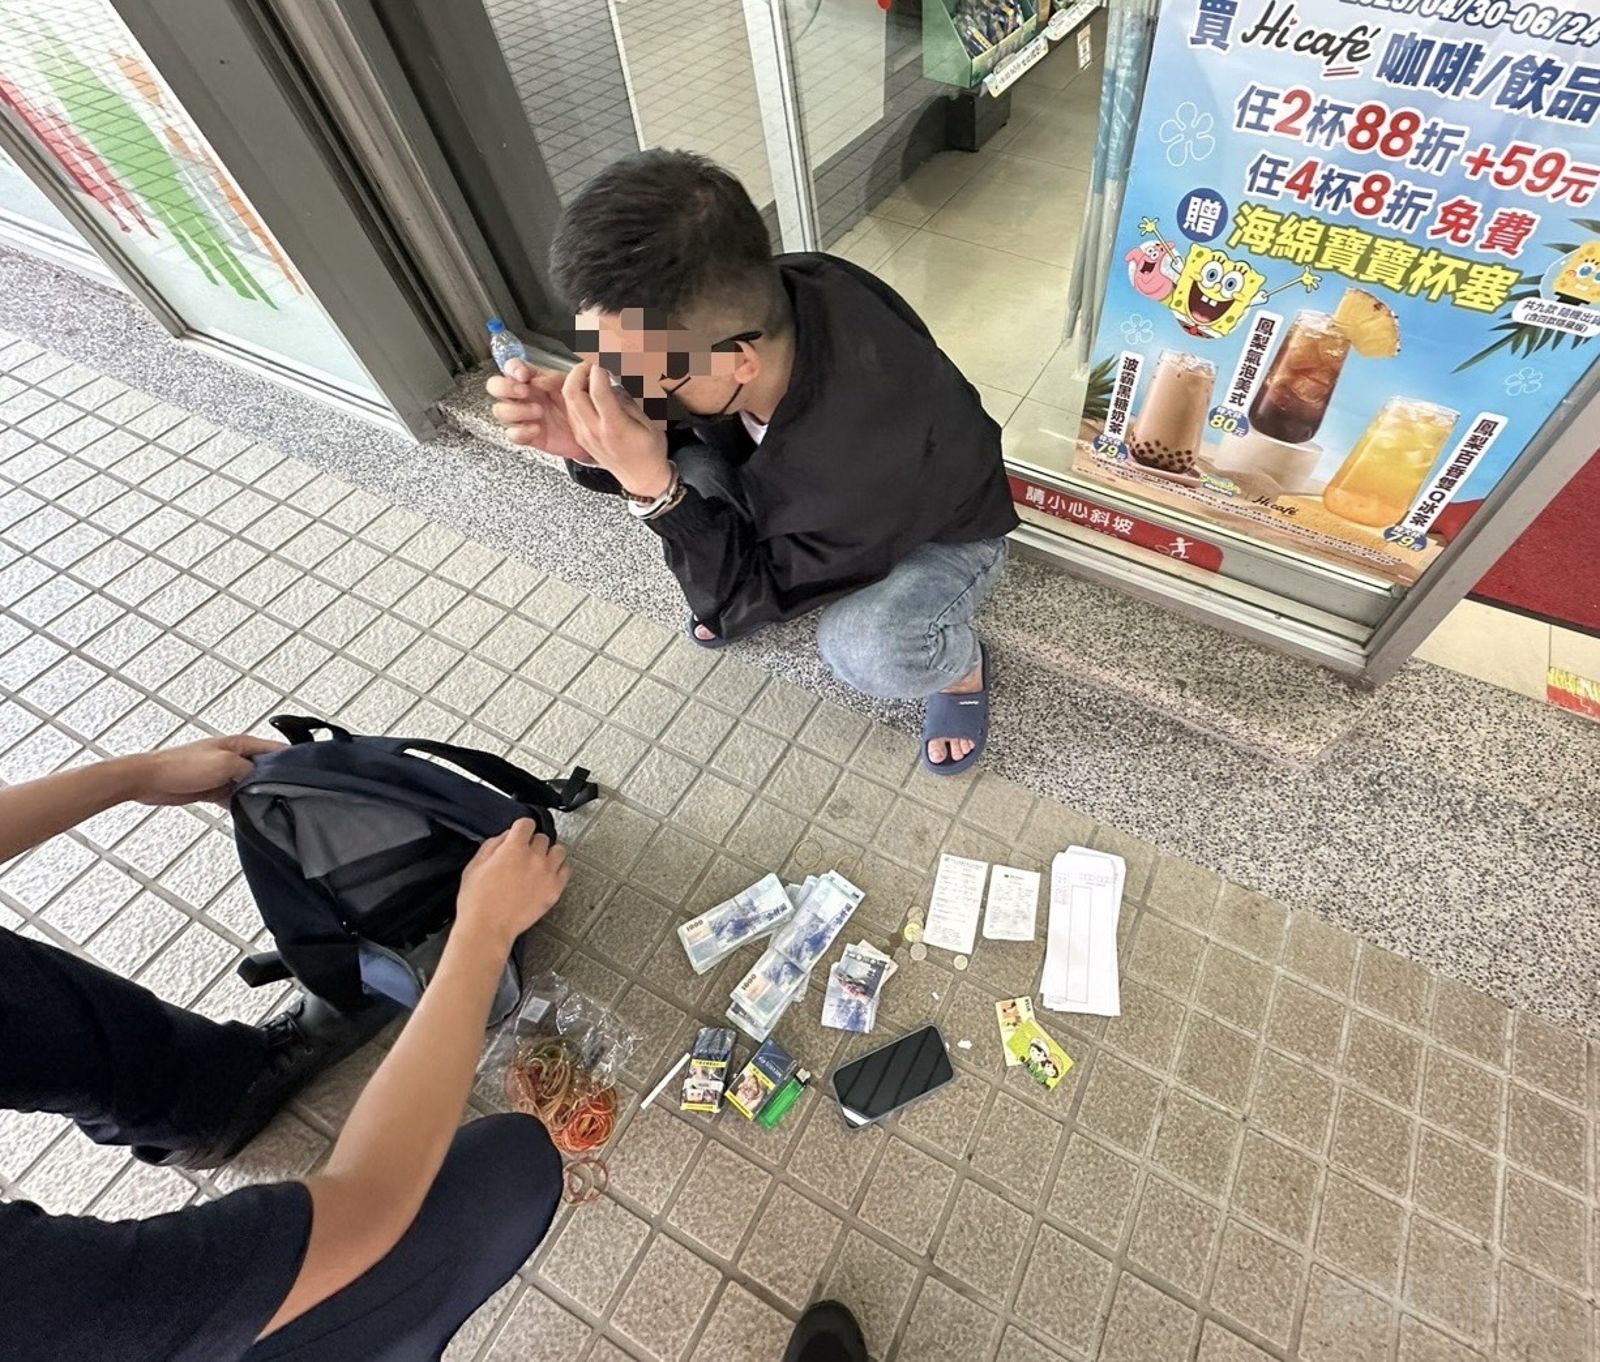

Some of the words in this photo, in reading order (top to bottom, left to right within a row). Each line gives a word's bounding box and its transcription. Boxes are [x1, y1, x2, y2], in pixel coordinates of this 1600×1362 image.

[1190, 0, 1238, 50] 買
[1241, 0, 1297, 48] Hi
[1294, 25, 1381, 65] café
[1376, 32, 1600, 123] 咖啡/飲品
[1236, 85, 1466, 172] 任2杯88折
[1466, 144, 1600, 204] +59元
[1182, 196, 1222, 237] 贈
[1247, 153, 1433, 231] 任4杯8折
[1430, 198, 1536, 256] 免費
[1226, 200, 1521, 313] 海綿寶寶杯塞
[1109, 356, 1140, 435] 波霸黑糖奶茶
[1228, 317, 1276, 407] 鳳梨氣泡美式
[1210, 414, 1246, 437] 80元
[1025, 485, 1135, 535] 請小心斜坡
